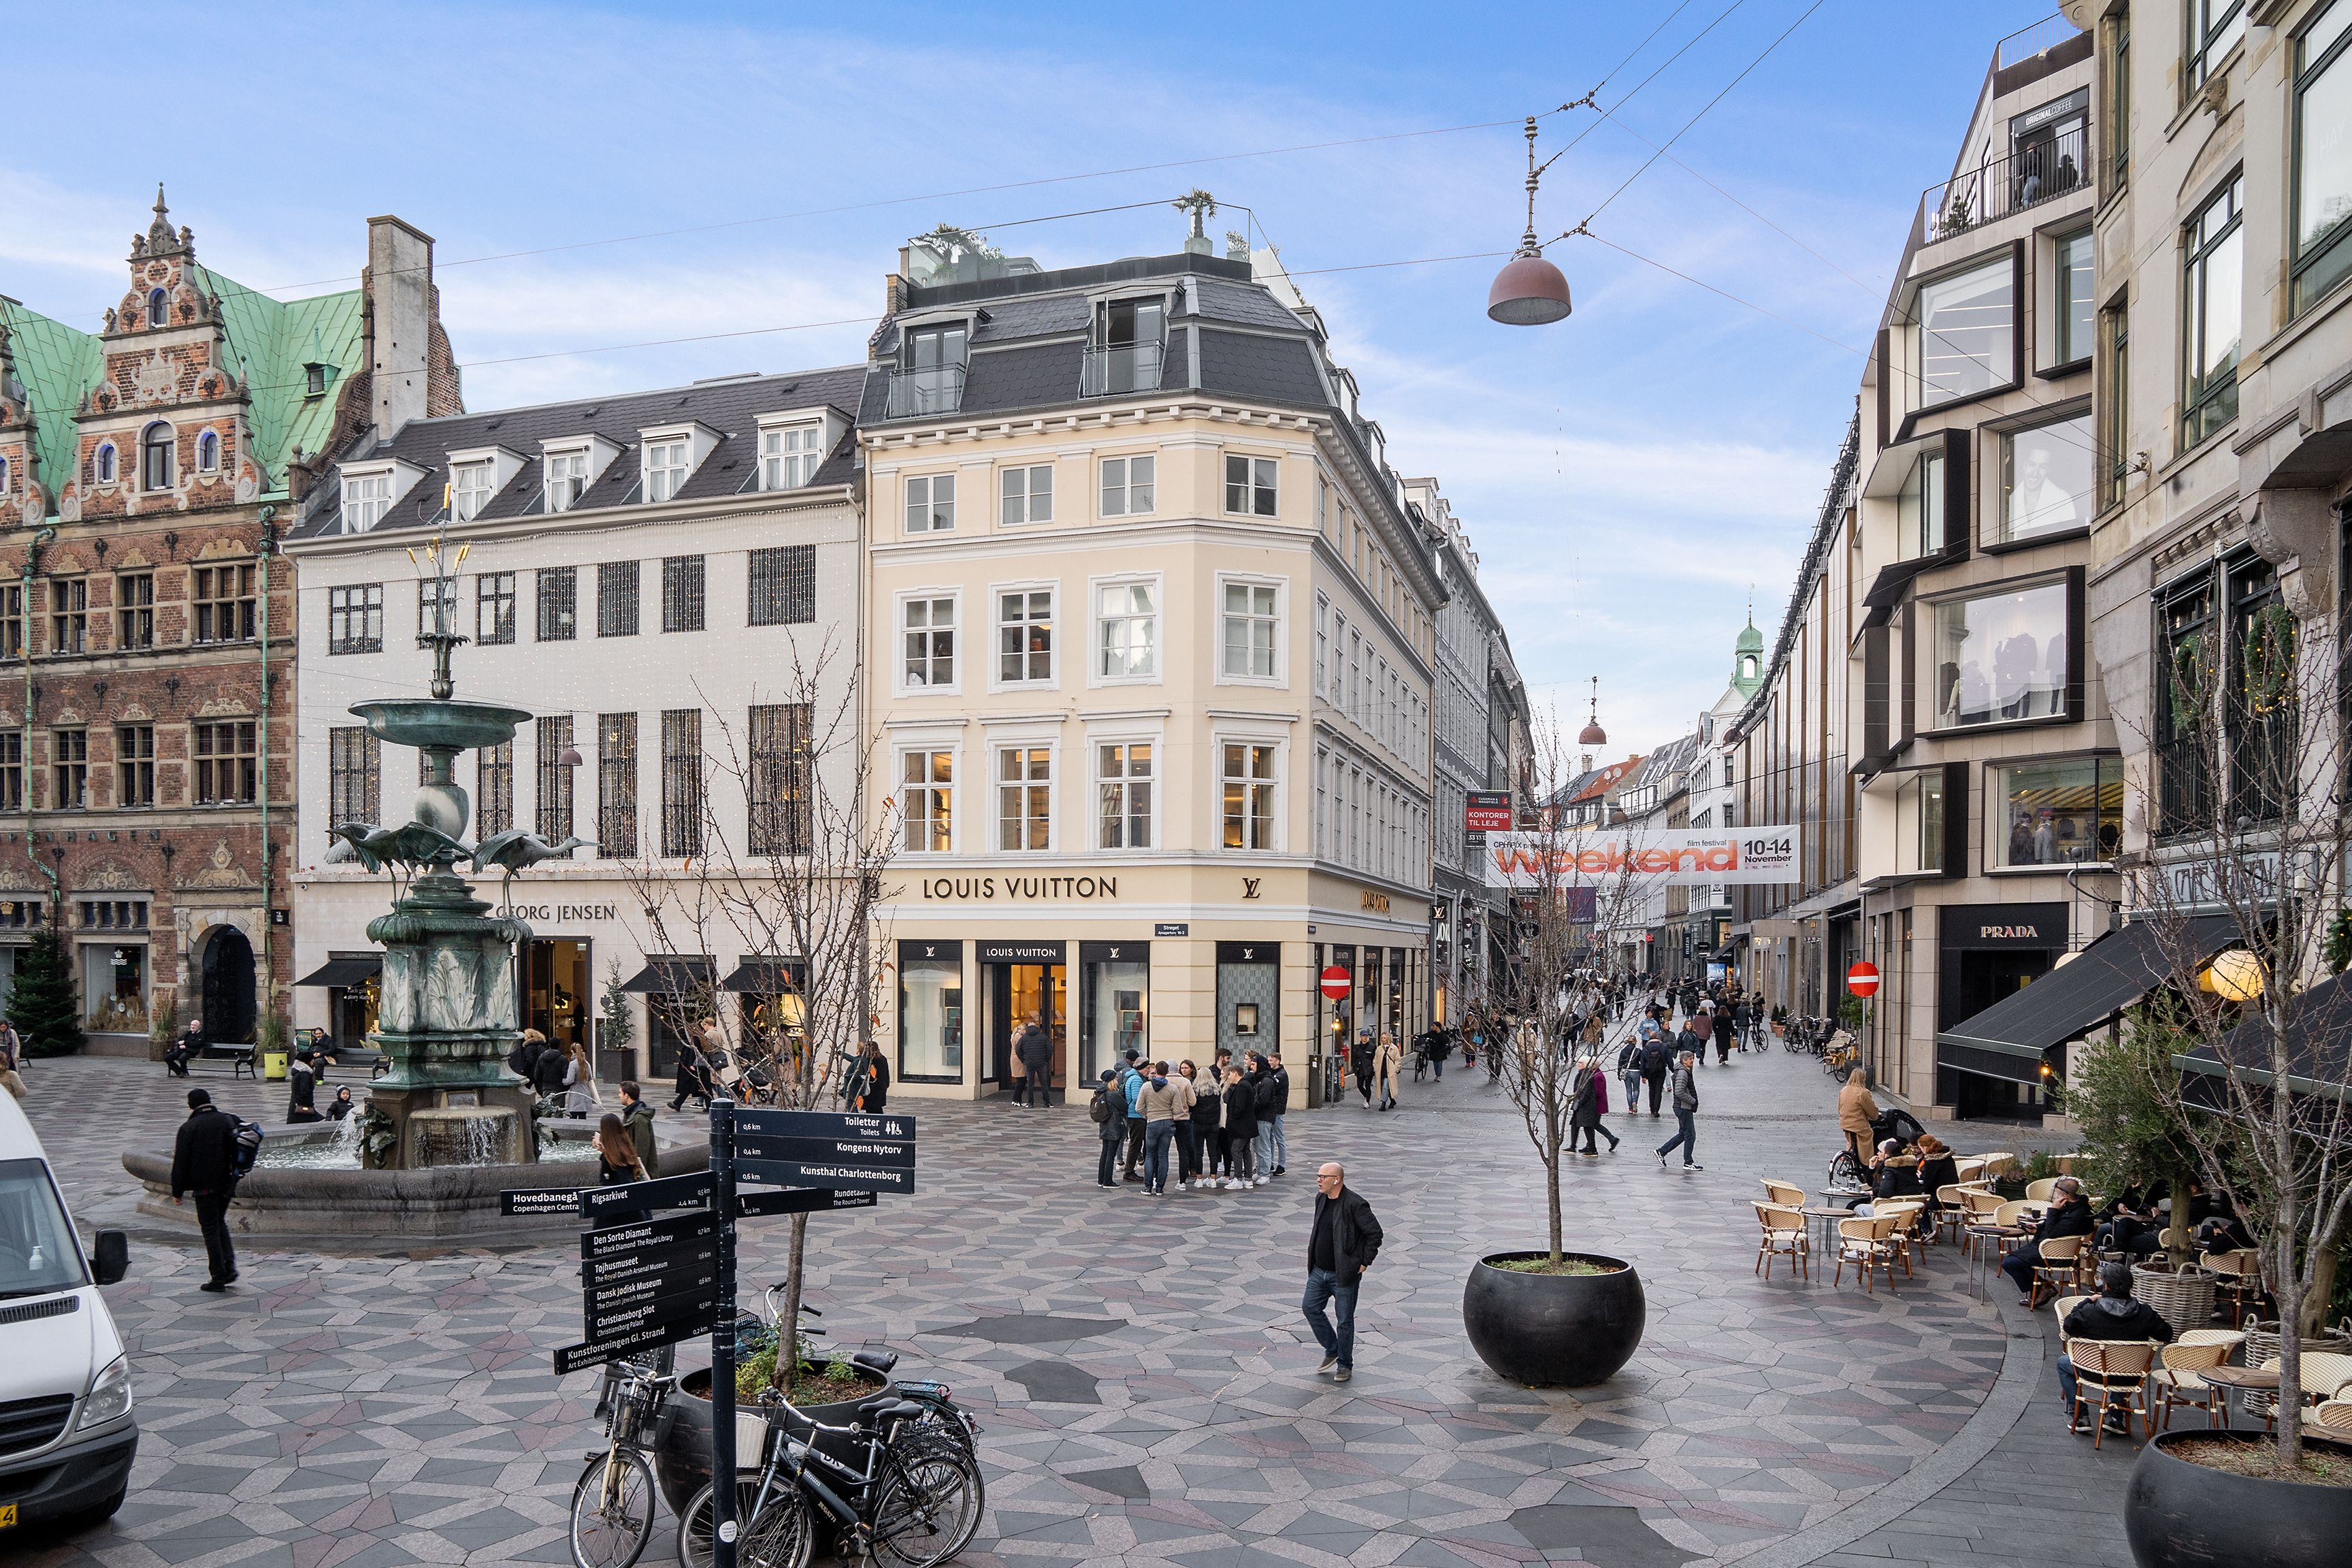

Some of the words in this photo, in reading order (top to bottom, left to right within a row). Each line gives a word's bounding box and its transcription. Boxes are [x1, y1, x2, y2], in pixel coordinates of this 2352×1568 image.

[1744, 838, 1792, 855] 10-14
[1495, 839, 1738, 873] weekend
[1744, 855, 1793, 863] November
[924, 878, 995, 898] LOUIS
[1004, 876, 1116, 898] VUITTON
[557, 905, 615, 923] JENSEN
[1980, 926, 2038, 938] PRADA
[986, 948, 1013, 957] LOUIS
[1015, 948, 1056, 957] VUITTON
[845, 1117, 880, 1126] Toiletter
[837, 1143, 872, 1154] Kongens
[873, 1144, 902, 1155] Nytorv
[800, 1166, 836, 1177] Kunsthal
[838, 1168, 901, 1182] Charlottenborg
[591, 1190, 628, 1205] Rigsarkivet
[513, 1204, 555, 1213] Copenhagen
[593, 1235, 607, 1245] Den
[607, 1232, 625, 1243] Sorte
[625, 1227, 651, 1239] Diamant
[602, 1244, 615, 1254] Black
[616, 1241, 636, 1251] Diamond
[646, 1236, 658, 1246] Royal
[658, 1234, 673, 1244] Library
[604, 1273, 617, 1282] Royal
[617, 1268, 633, 1279] Danish
[633, 1265, 649, 1275] Arsenal
[649, 1261, 668, 1272] Museum
[597, 1288, 617, 1301] Dansk
[636, 1278, 662, 1290] Museum
[606, 1299, 621, 1309] Danish
[621, 1294, 636, 1305] Jewish
[636, 1290, 655, 1301] Museum
[597, 1309, 642, 1328] Christiansborg
[642, 1305, 655, 1315] Slot
[597, 1323, 630, 1337] Christiansborg
[630, 1318, 644, 1328] Palace
[568, 1338, 630, 1360] Kunstforeningen
[631, 1333, 640, 1342] Gl.
[642, 1326, 665, 1340] Strand
[577, 1354, 608, 1367] Exhibitions
